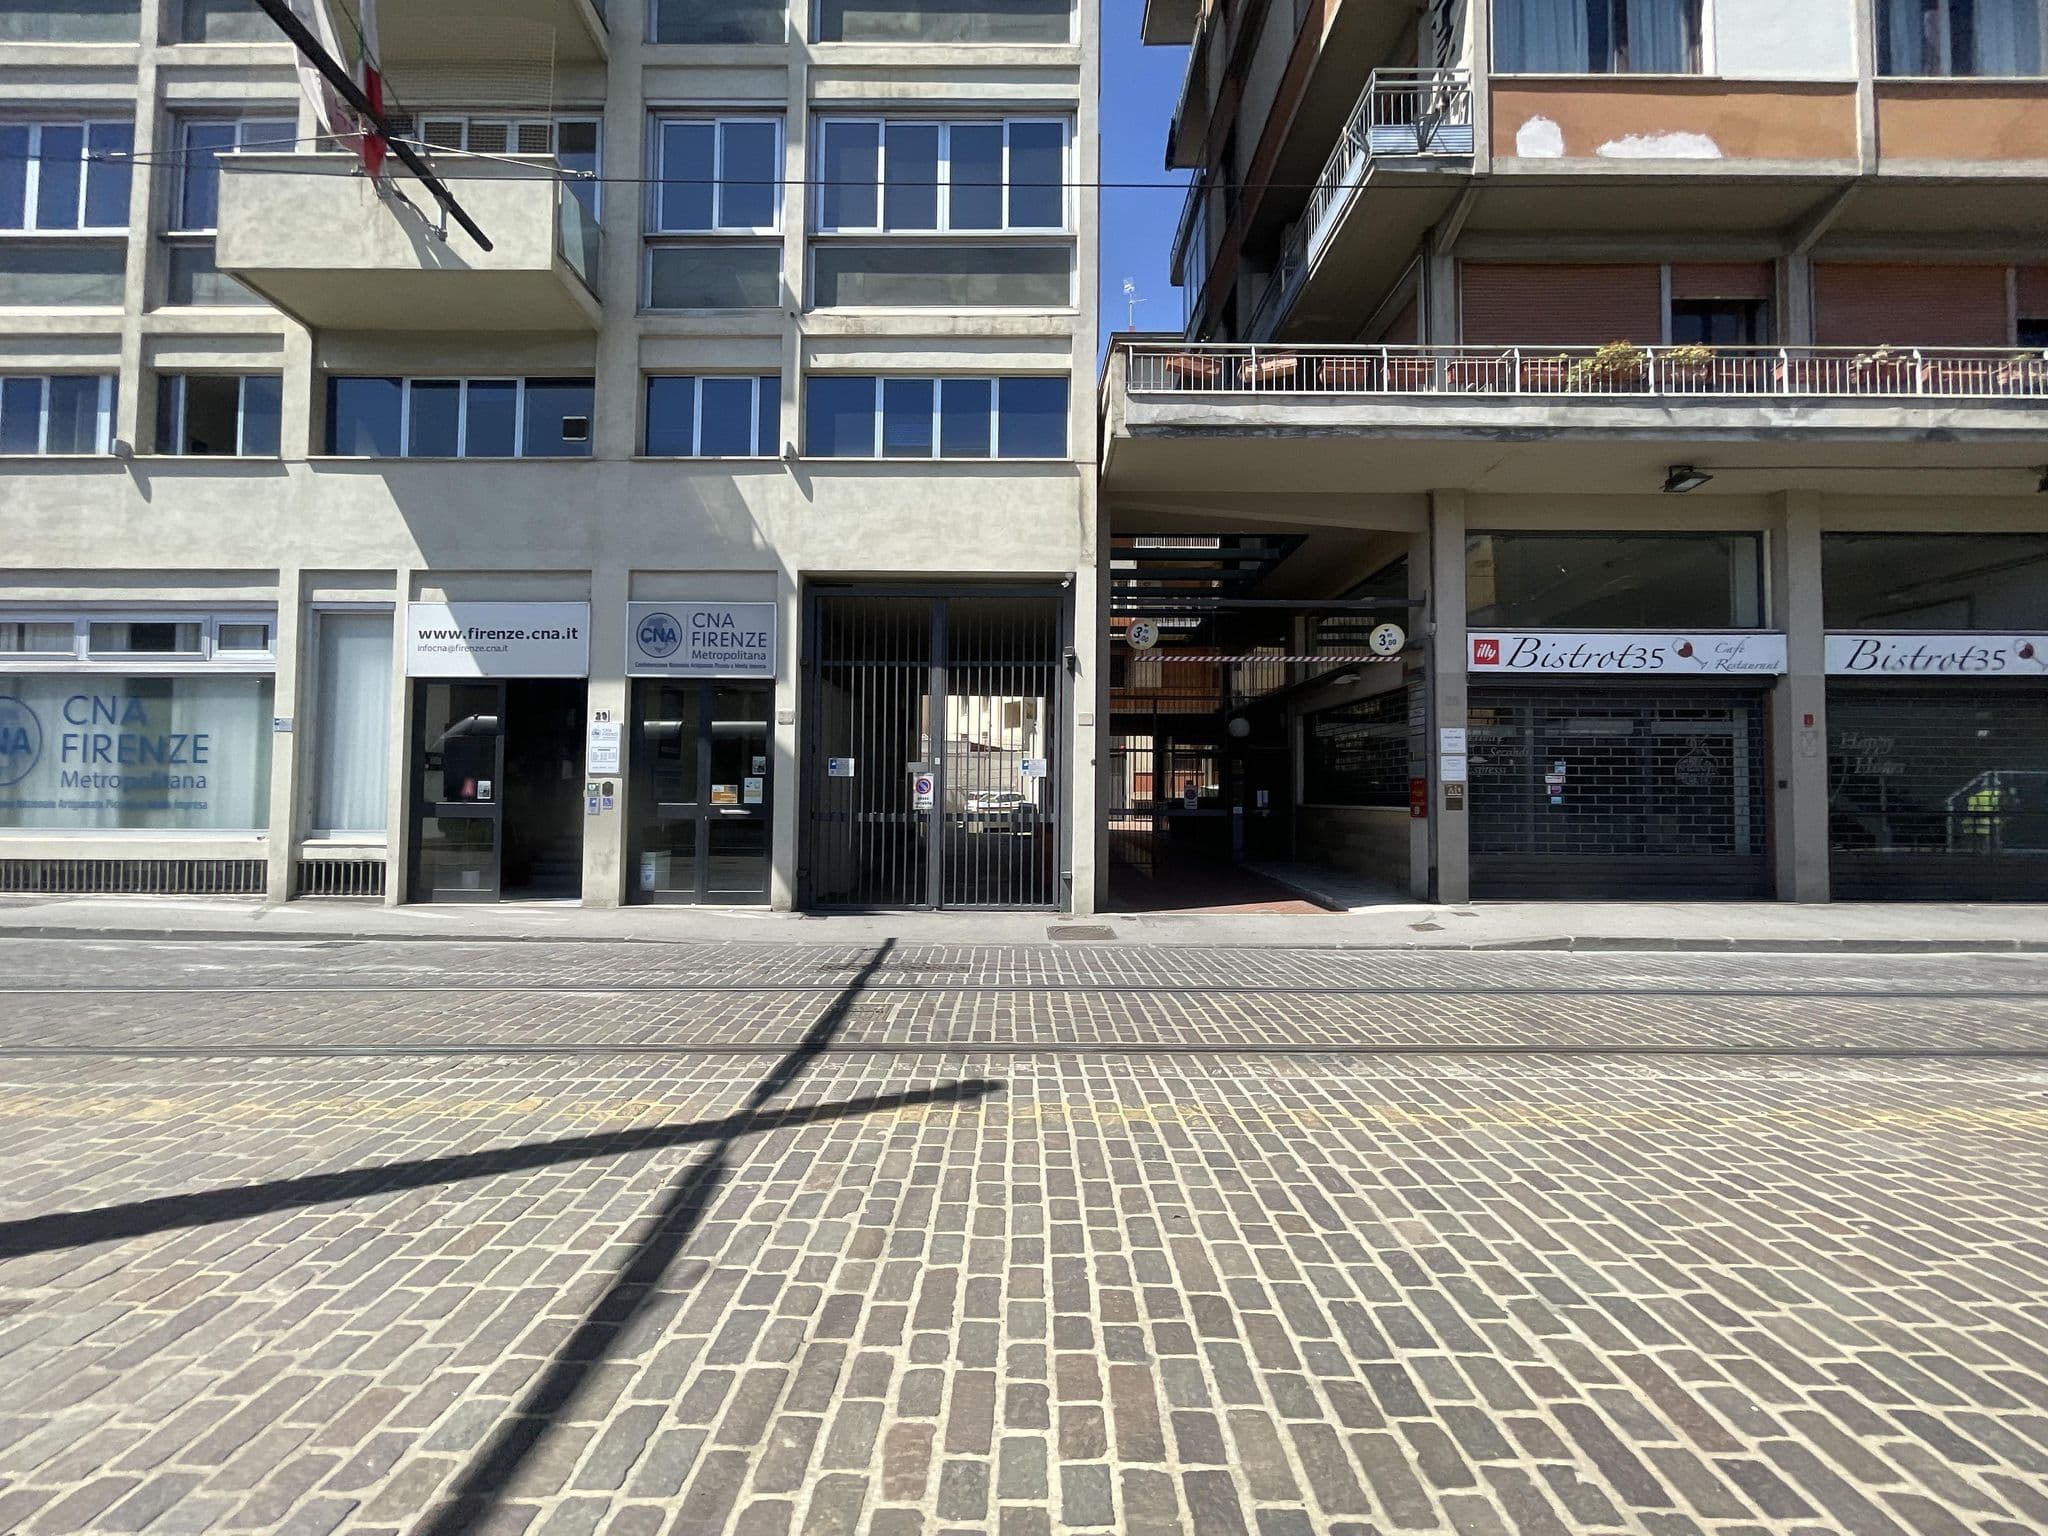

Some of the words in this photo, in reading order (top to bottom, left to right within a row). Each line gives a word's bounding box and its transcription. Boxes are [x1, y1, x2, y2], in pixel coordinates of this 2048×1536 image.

[692, 612, 735, 629] CNA
[418, 627, 579, 640] www.firenze.cna.it
[640, 627, 678, 643] CNA
[691, 631, 767, 648] FIRENZE
[417, 644, 509, 653] infocna@firenze.cna.it
[691, 650, 767, 661] Metropolitana
[1477, 643, 1497, 661] illy
[1505, 637, 1666, 669] Bistrot35
[1844, 639, 2007, 671] Bistrot35
[1716, 658, 1780, 673] Restaurant
[63, 695, 147, 726] CNA
[0, 727, 32, 754] NA
[62, 734, 209, 764] FIRENZE
[61, 770, 207, 793] Metropolitana
